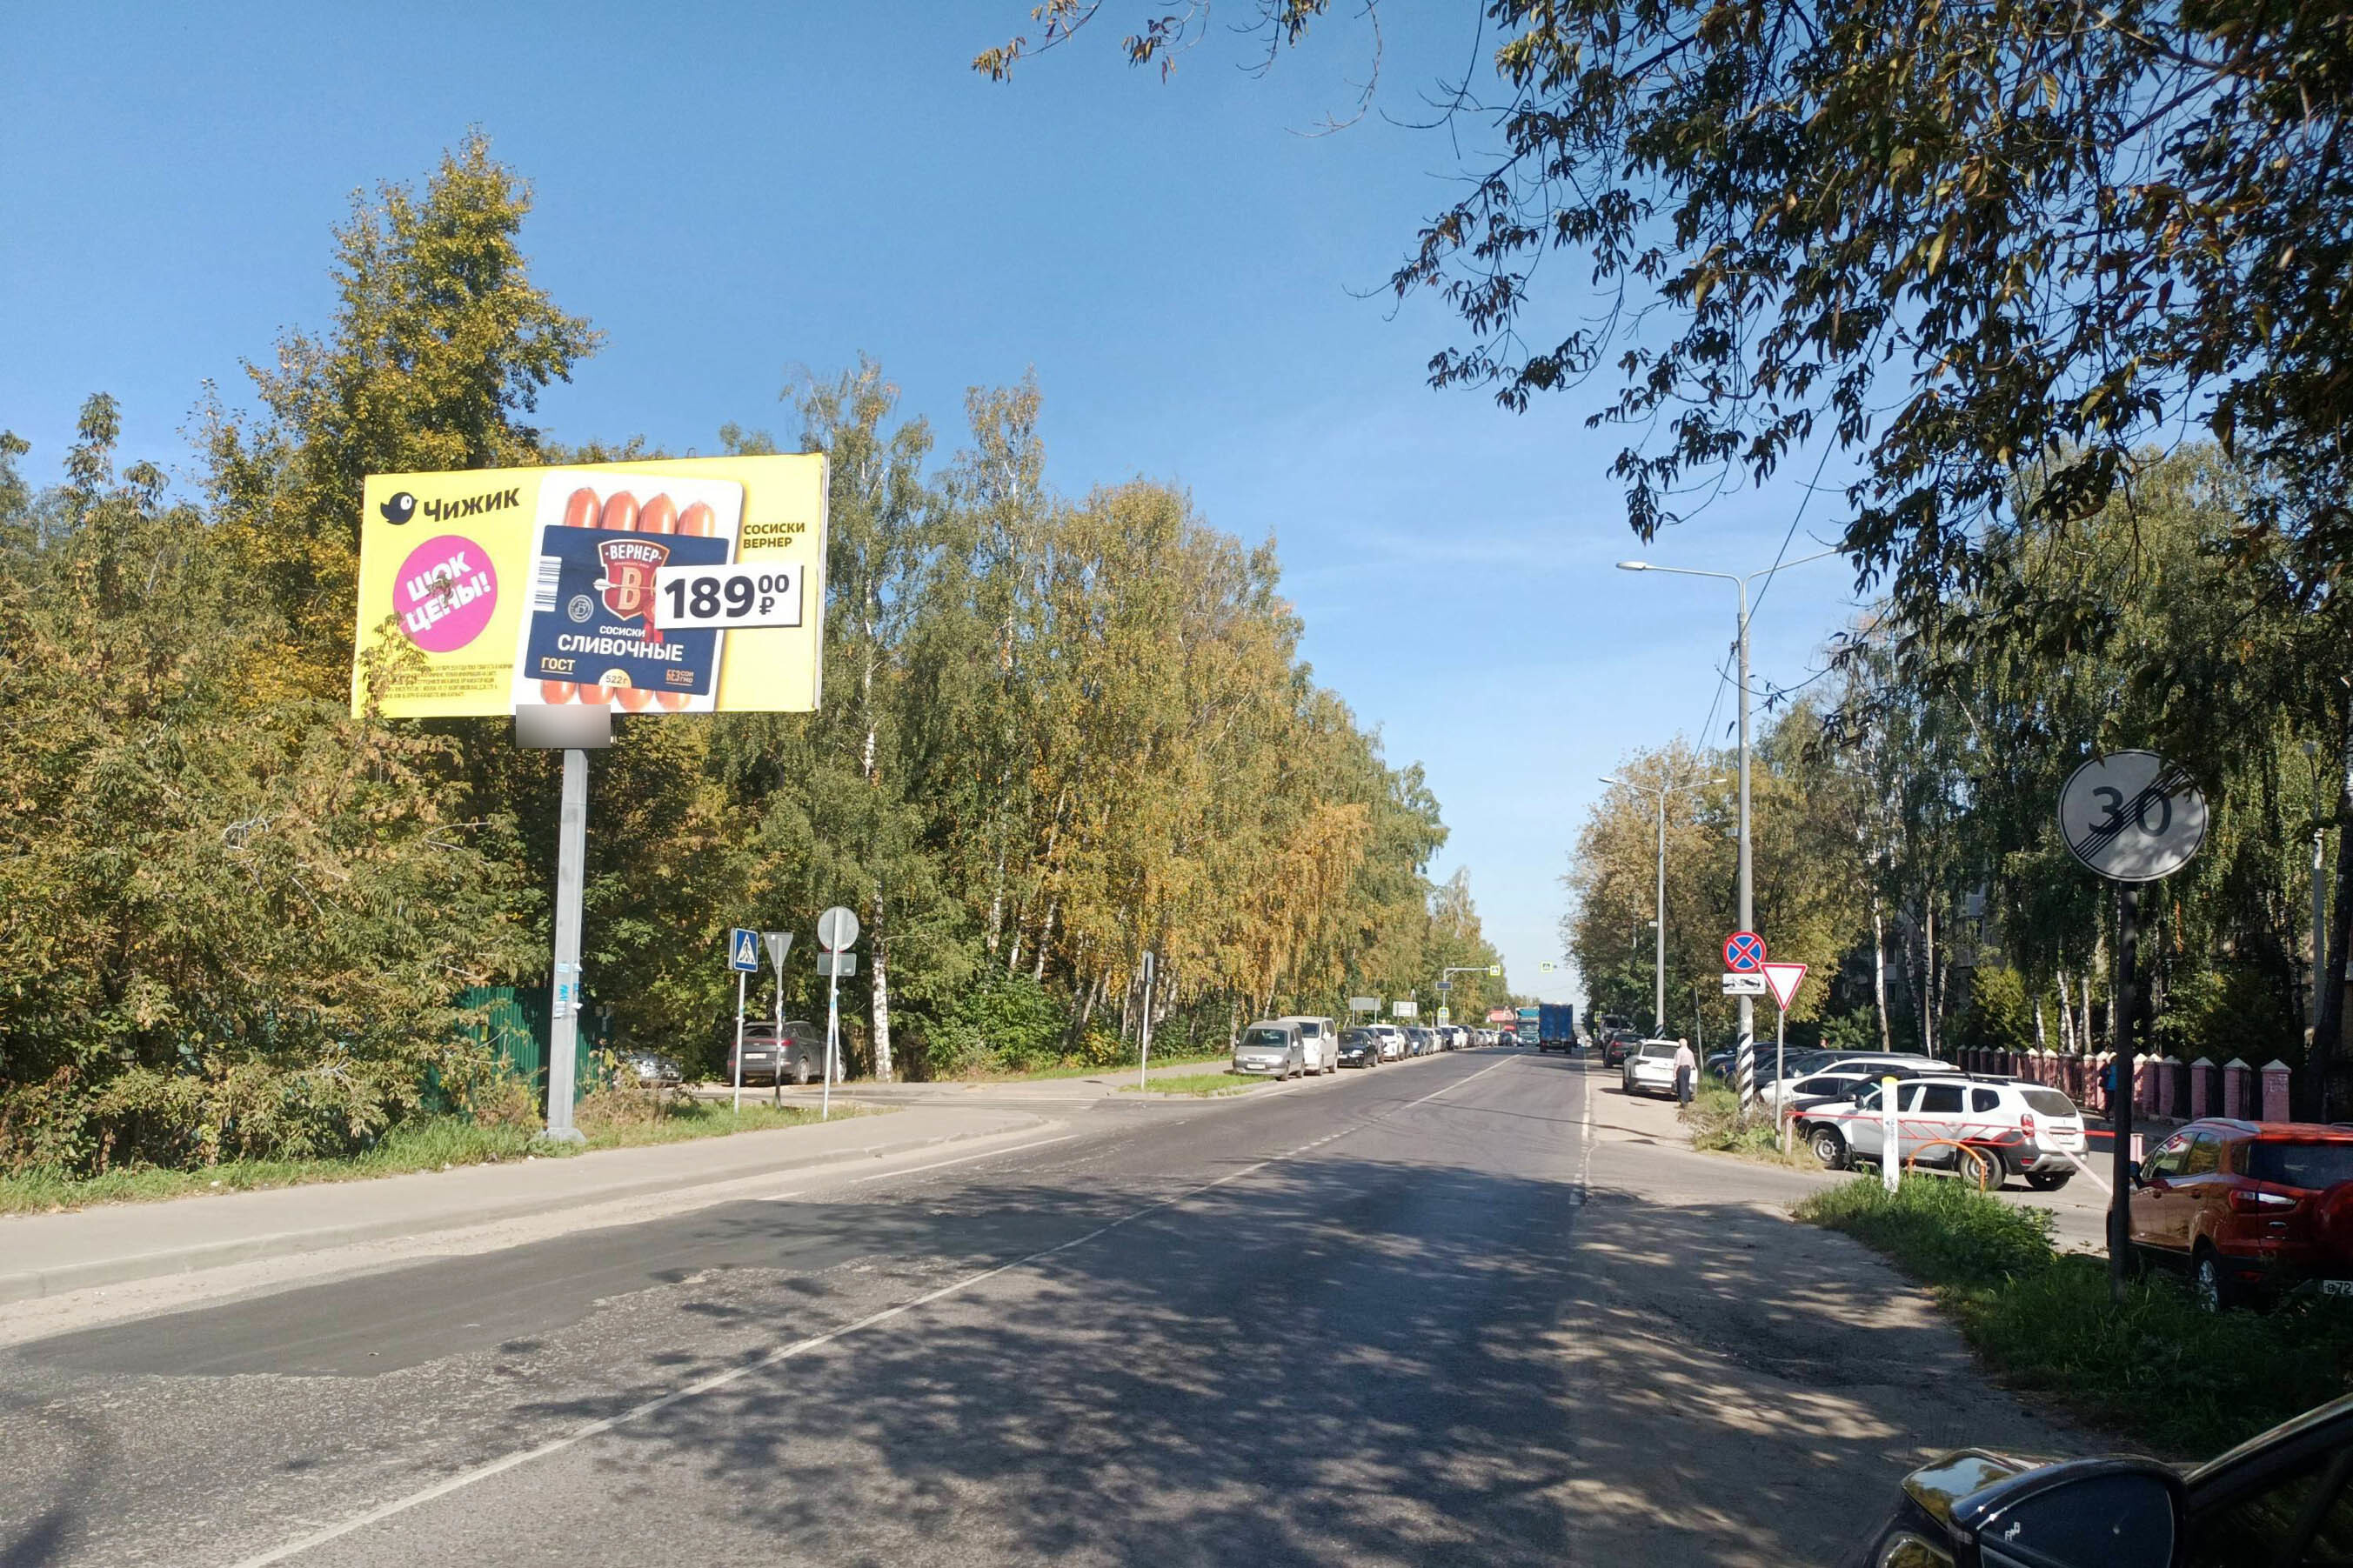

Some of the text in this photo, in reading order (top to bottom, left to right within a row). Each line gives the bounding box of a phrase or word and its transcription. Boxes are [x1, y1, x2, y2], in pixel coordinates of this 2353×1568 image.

[744, 523, 806, 535] СОСИСКИ
[743, 537, 792, 549] ВЕРНЕР
[610, 544, 659, 563] ВЕРНЕР
[664, 575, 755, 618] 189
[599, 625, 645, 637] СОСИСКИ
[558, 634, 684, 662] СЛИВОЧНЫЕ
[541, 657, 576, 671] ГОСТ
[605, 675, 628, 684] 522г
[2089, 786, 2172, 837] 30
